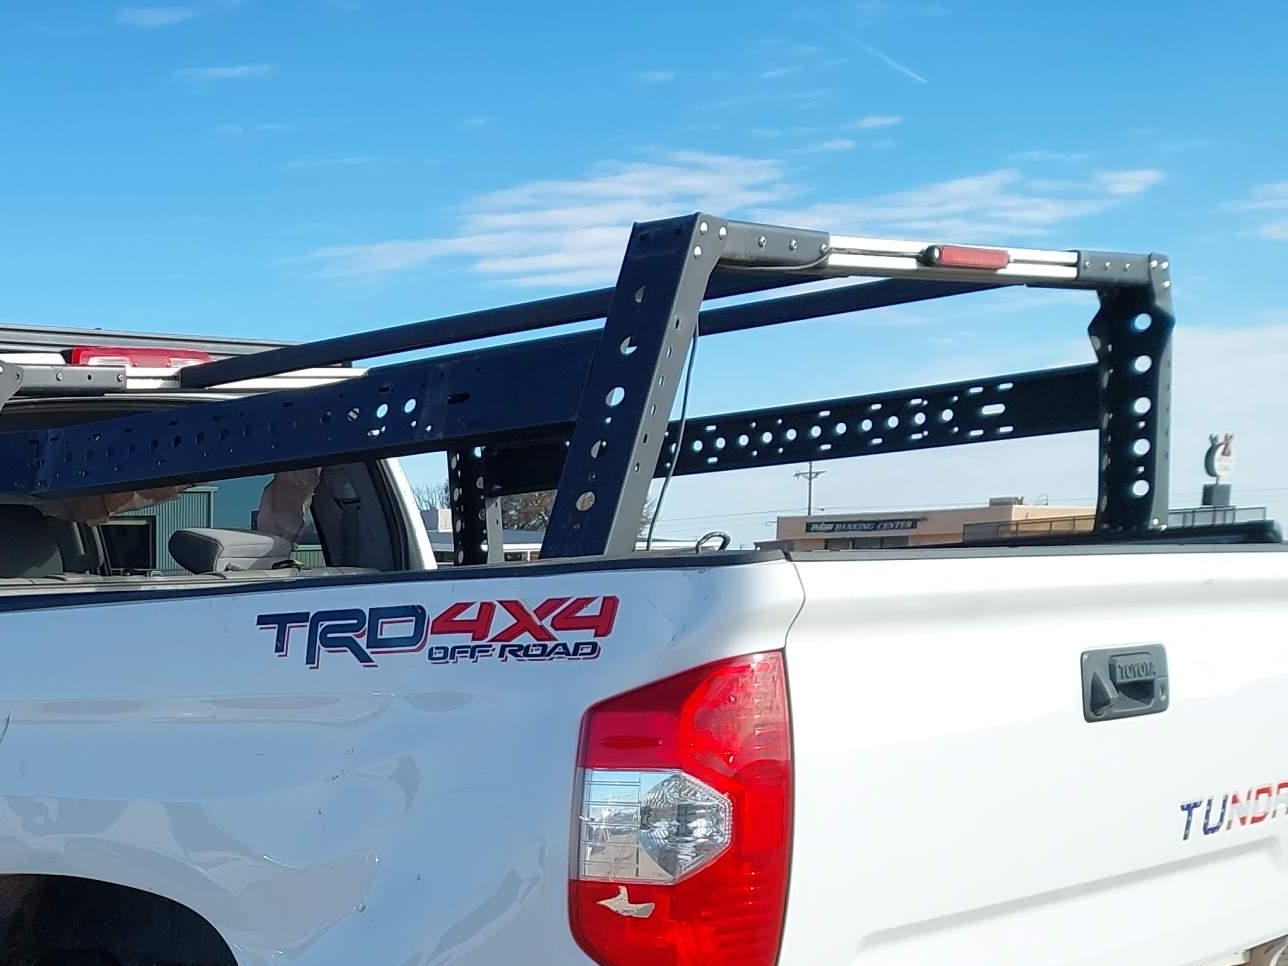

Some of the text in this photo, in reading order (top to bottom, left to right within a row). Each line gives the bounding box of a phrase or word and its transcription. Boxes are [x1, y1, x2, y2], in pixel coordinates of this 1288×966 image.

[256, 594, 621, 670] TRD 4X4
[426, 641, 601, 665] OFF ROAD
